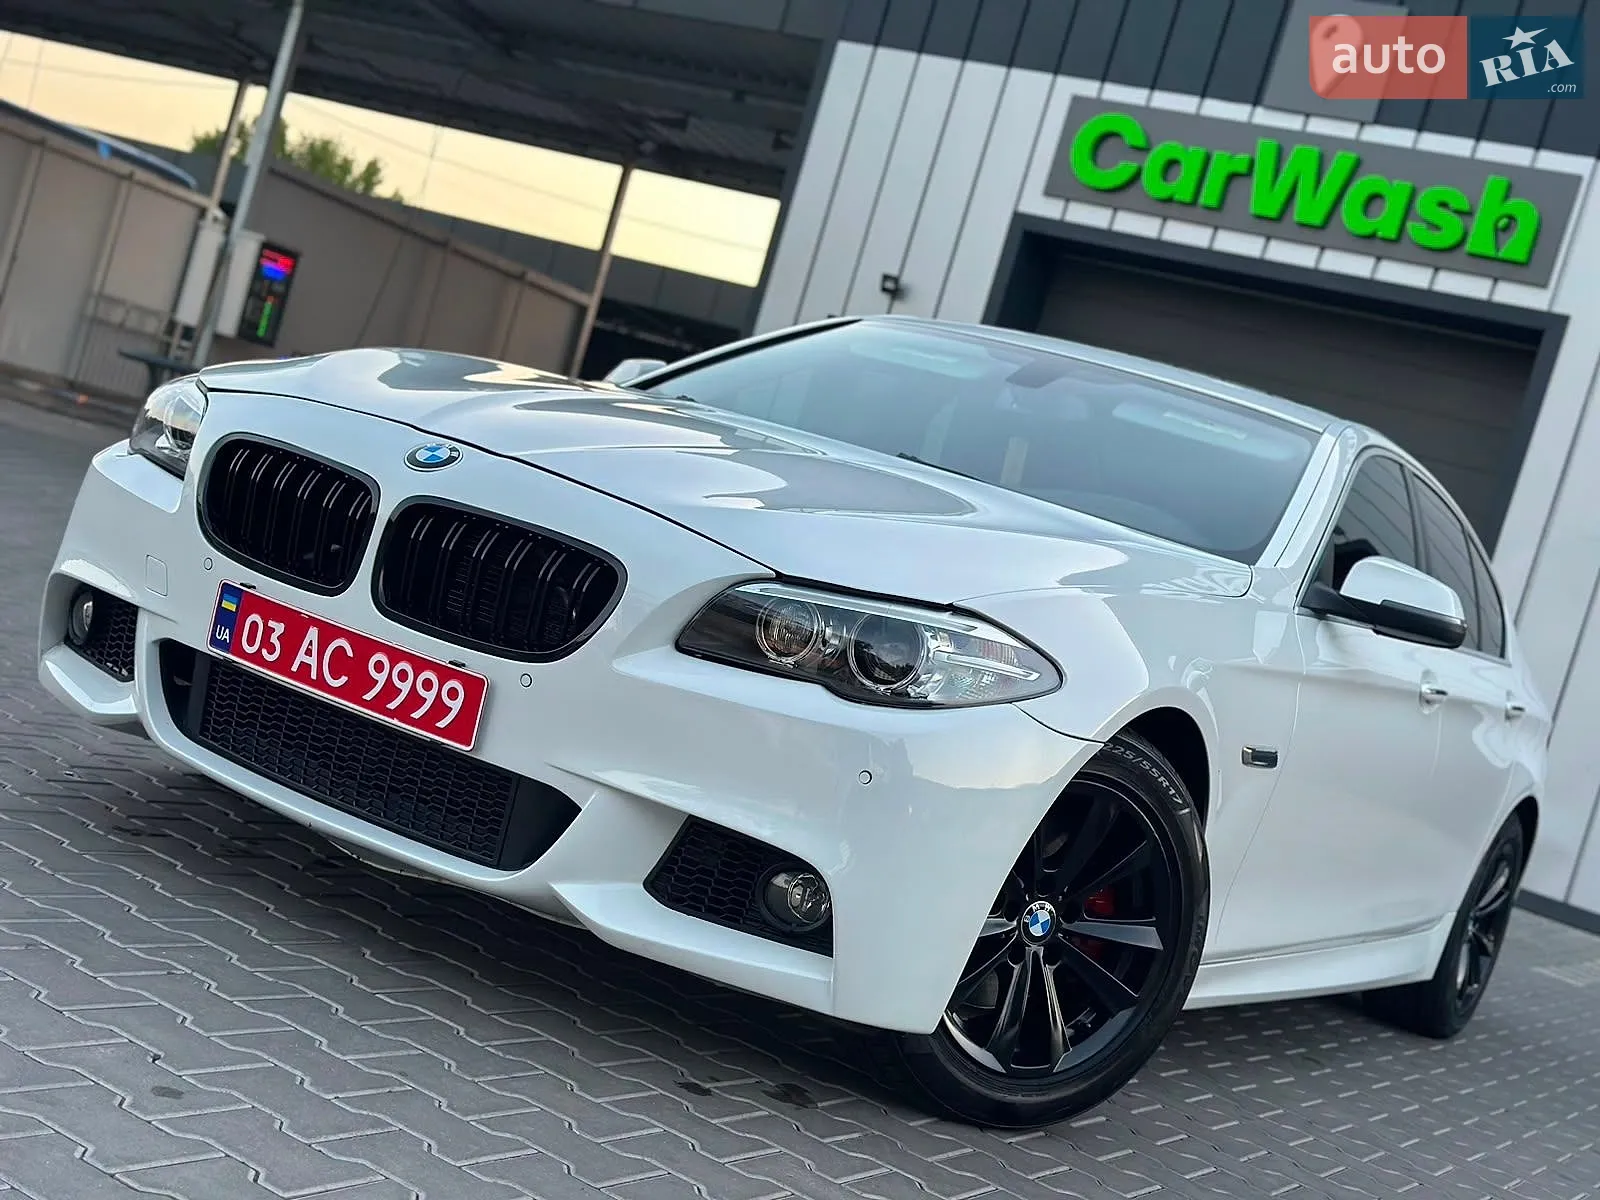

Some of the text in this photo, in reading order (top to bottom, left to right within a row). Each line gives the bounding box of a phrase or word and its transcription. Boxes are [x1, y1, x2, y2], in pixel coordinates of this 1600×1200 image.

[1069, 111, 1542, 266] CarWash
[215, 624, 230, 644] UA
[241, 613, 466, 729] 03 AC 9999
[1103, 742, 1183, 804] 225/55R17
